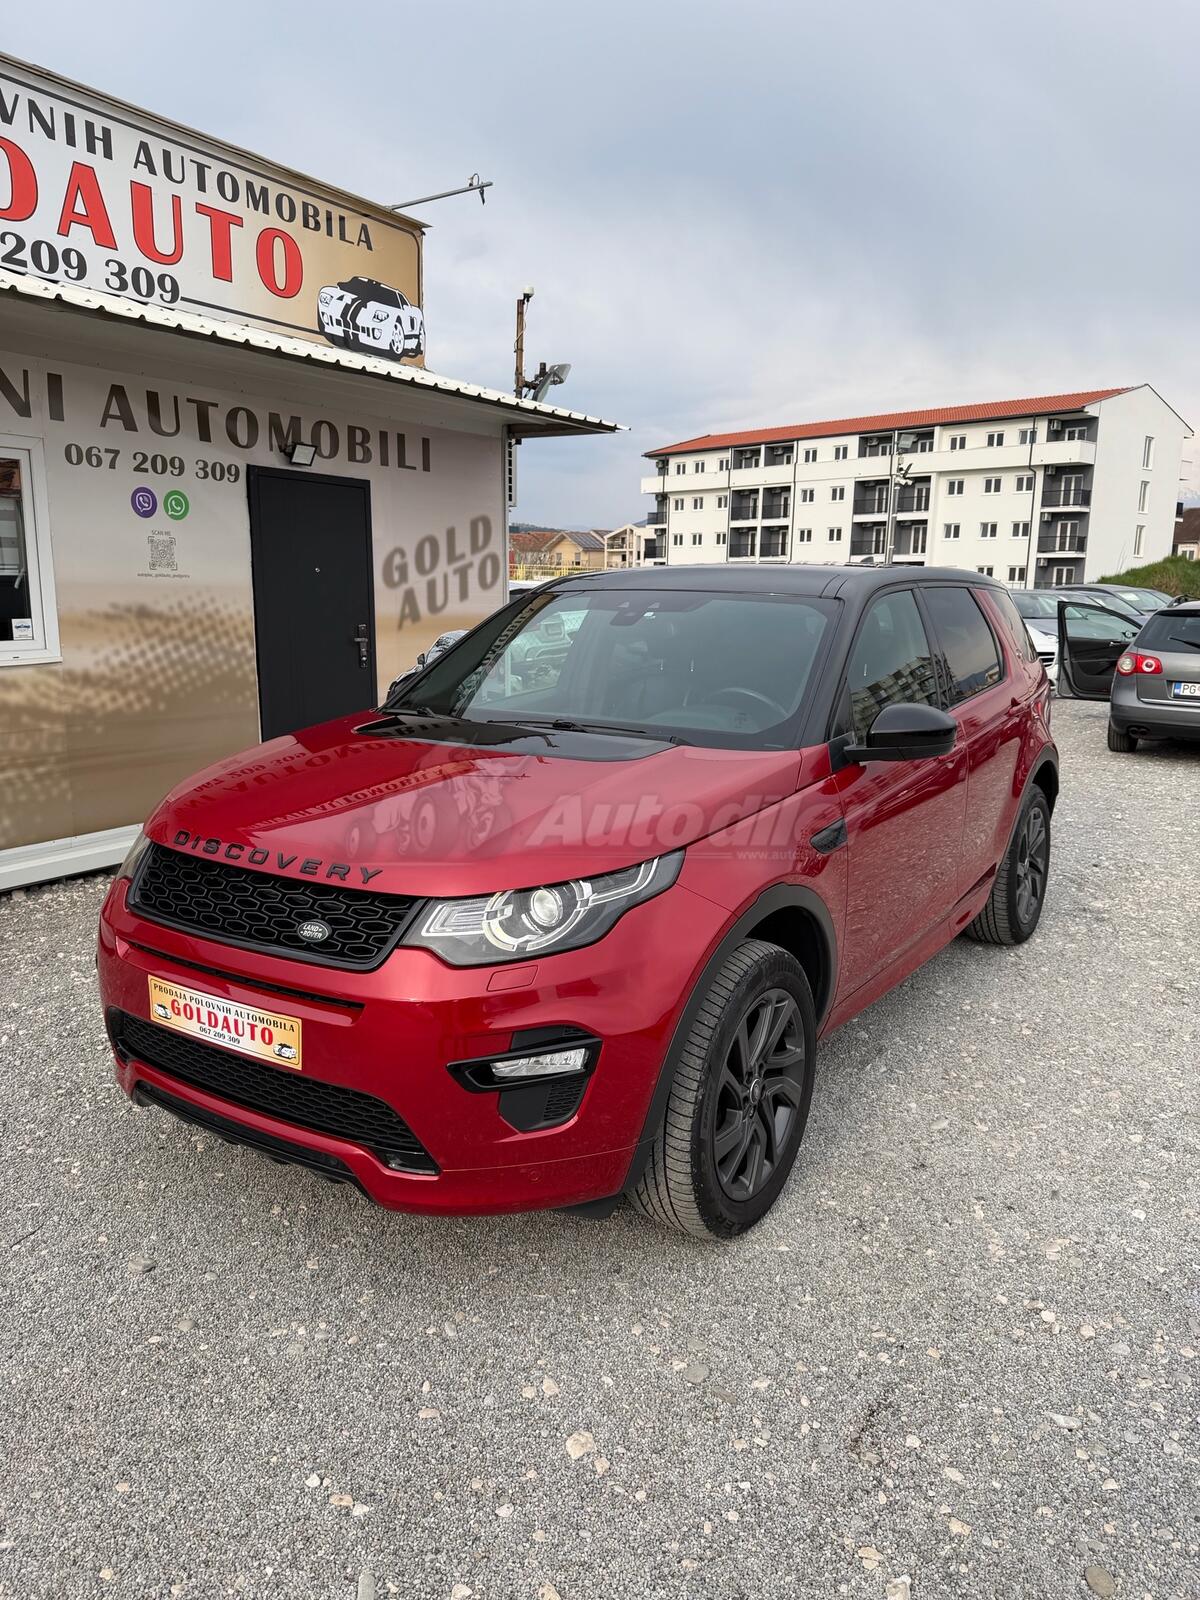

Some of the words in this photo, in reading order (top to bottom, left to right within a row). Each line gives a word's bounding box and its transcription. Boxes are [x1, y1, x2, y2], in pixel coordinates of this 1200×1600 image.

[133, 140, 373, 252] AUTOMOBILA
[0, 231, 88, 282] 209
[105, 258, 182, 305] 309
[0, 367, 65, 422] NI
[100, 383, 431, 473] AUTOMOBILI
[64, 443, 121, 470] 067
[132, 452, 186, 477] 209
[195, 459, 241, 483] 309
[382, 514, 493, 590] GOLD
[398, 550, 501, 632] AUTO
[1182, 684, 1197, 695] PG
[173, 830, 383, 885] DISCOVERY
[153, 983, 187, 1001] PRODAJA
[189, 996, 232, 1015] POLOVNIH
[234, 1009, 295, 1033] AUTOMOBILA
[170, 999, 274, 1046] GOLDAUTO
[199, 1026, 212, 1036] 067
[213, 1031, 226, 1040] 209
[227, 1035, 240, 1045] 309
